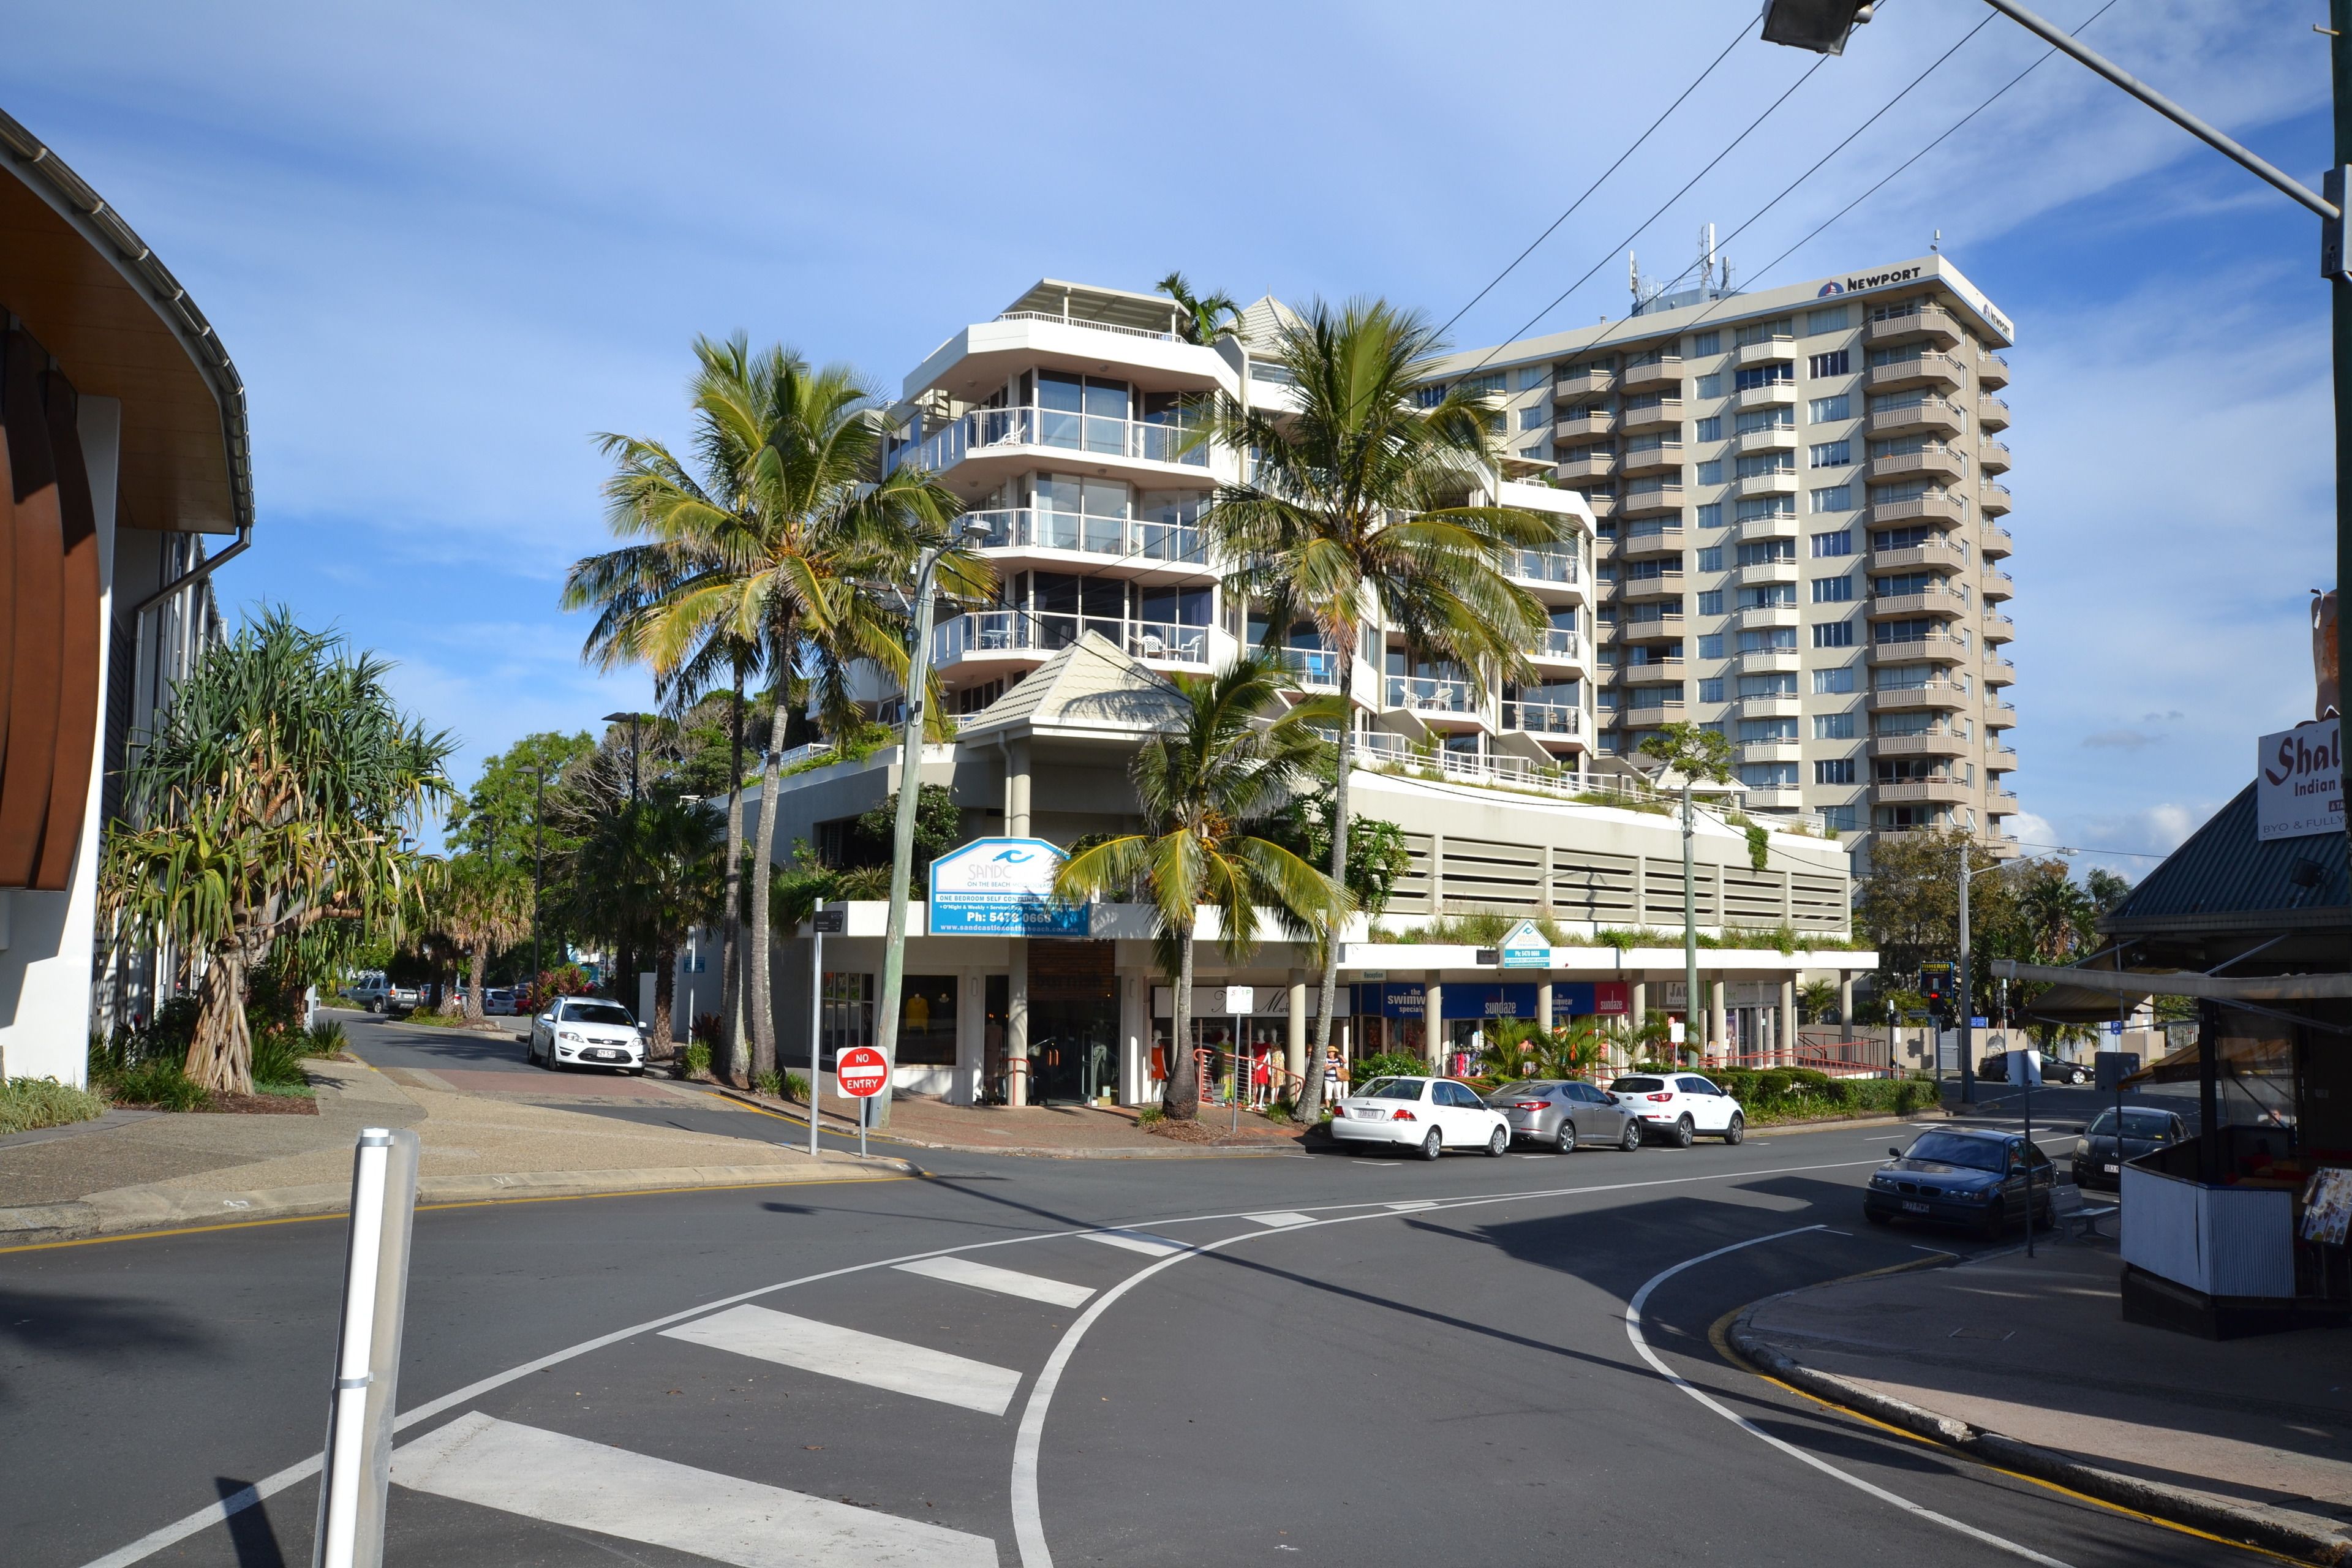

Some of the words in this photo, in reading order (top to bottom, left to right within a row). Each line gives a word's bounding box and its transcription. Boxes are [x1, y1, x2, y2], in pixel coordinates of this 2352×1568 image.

[1847, 266, 1921, 292] NEWPORT
[1991, 307, 2010, 337] NEWPORT
[2295, 779, 2336, 797] Indian
[2264, 823, 2289, 834] BYO
[2294, 821, 2302, 829] &
[2306, 814, 2345, 827] FULLY
[967, 911, 986, 922] Ph:
[1485, 987, 1517, 1014] sundaze
[1600, 990, 1623, 1010] sundaze
[856, 1054, 869, 1063] NO
[846, 1079, 878, 1089] ENTRY
